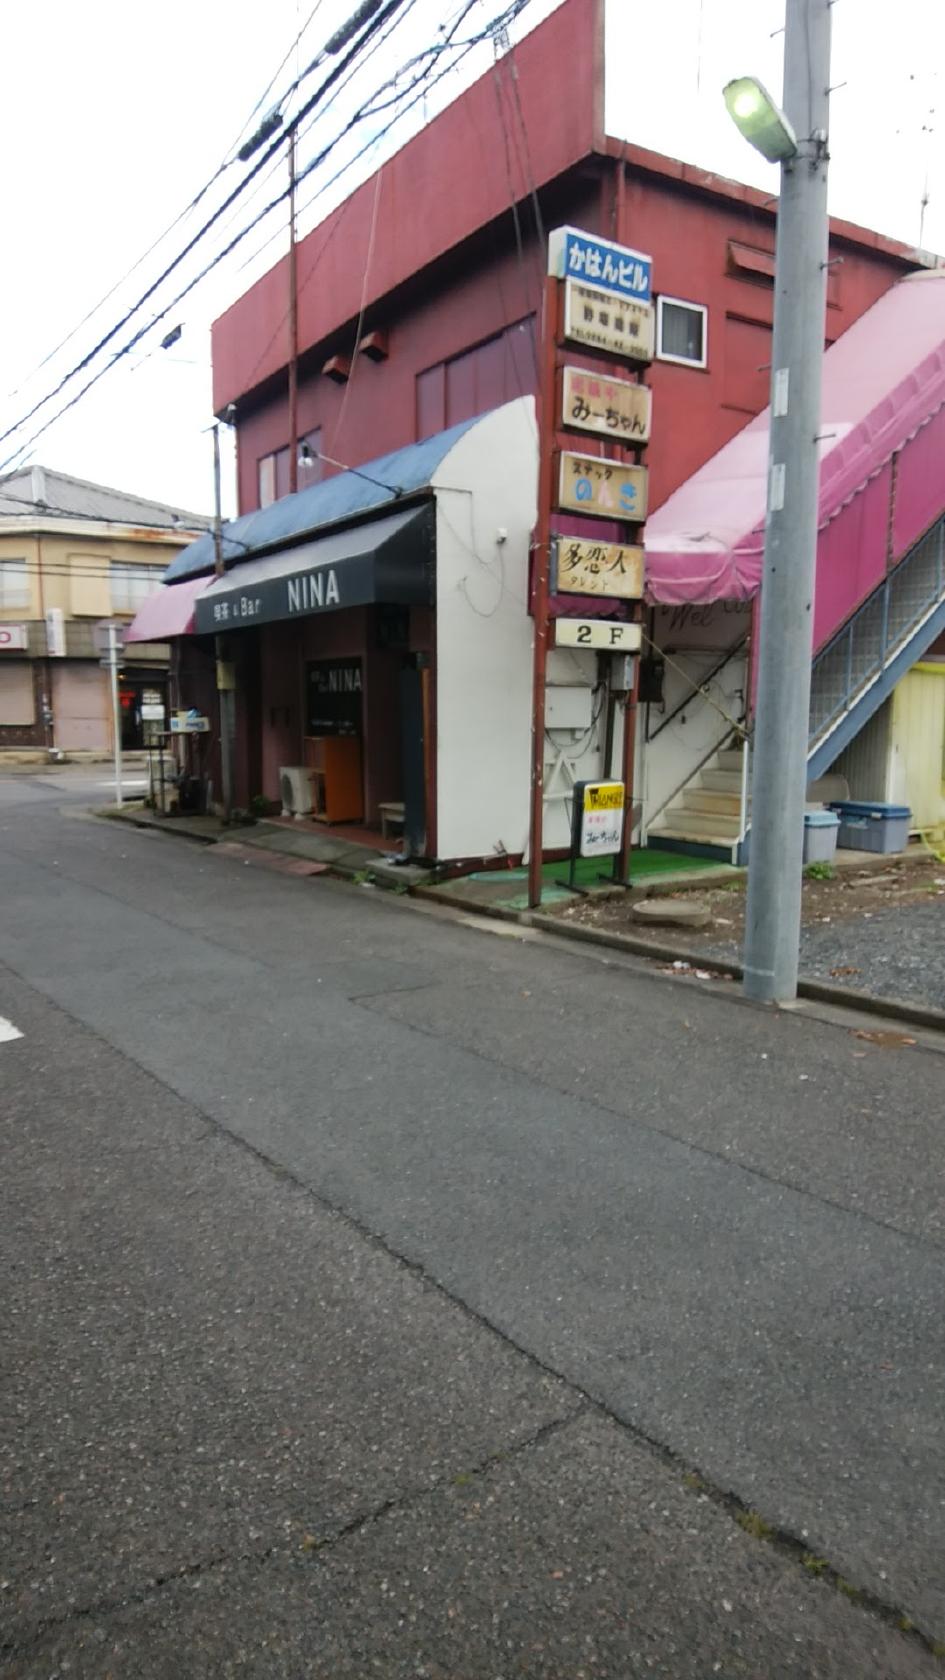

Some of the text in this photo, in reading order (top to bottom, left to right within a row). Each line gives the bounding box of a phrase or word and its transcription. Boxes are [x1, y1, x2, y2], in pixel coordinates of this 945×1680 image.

[572, 396, 646, 435] みーちゃん
[572, 461, 613, 481] スナック
[562, 543, 627, 575] 多恋人
[241, 596, 262, 618] Bar
[287, 569, 341, 613] NINA
[570, 576, 609, 592] タレント
[328, 668, 363, 693] NINA
